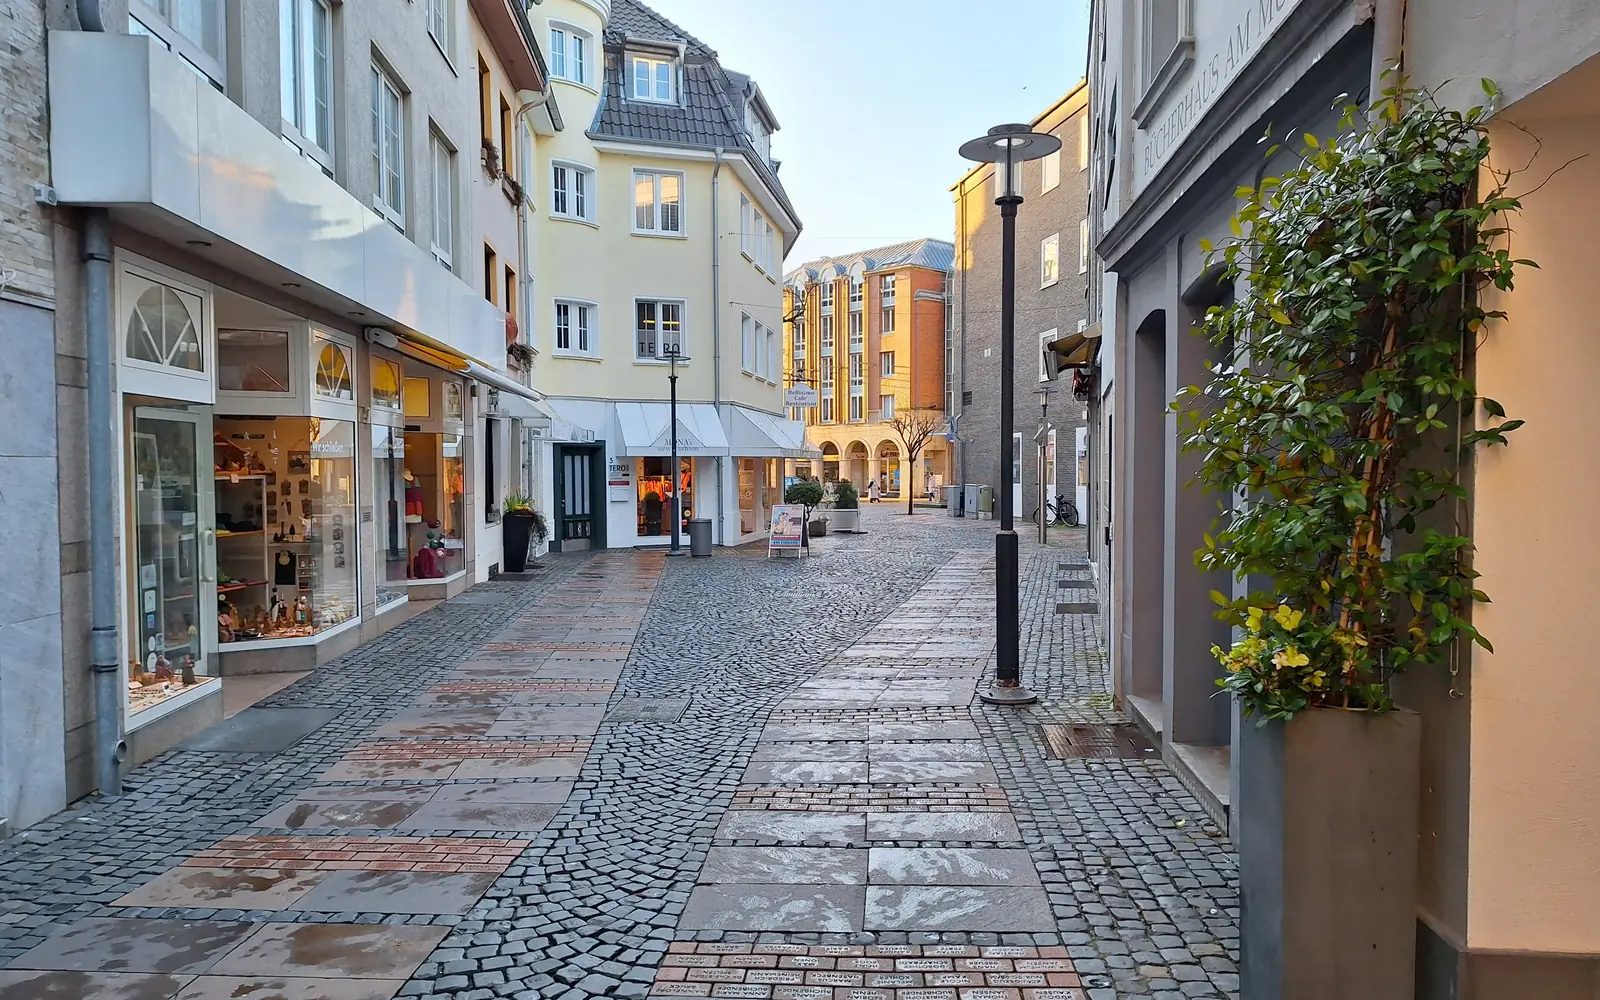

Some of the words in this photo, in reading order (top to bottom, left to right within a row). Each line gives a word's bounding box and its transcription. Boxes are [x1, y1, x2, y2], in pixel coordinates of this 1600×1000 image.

[1143, 53, 1220, 177] BÜCHERHAUS
[1224, 8, 1252, 80] AM
[1257, 0, 1286, 38] M
